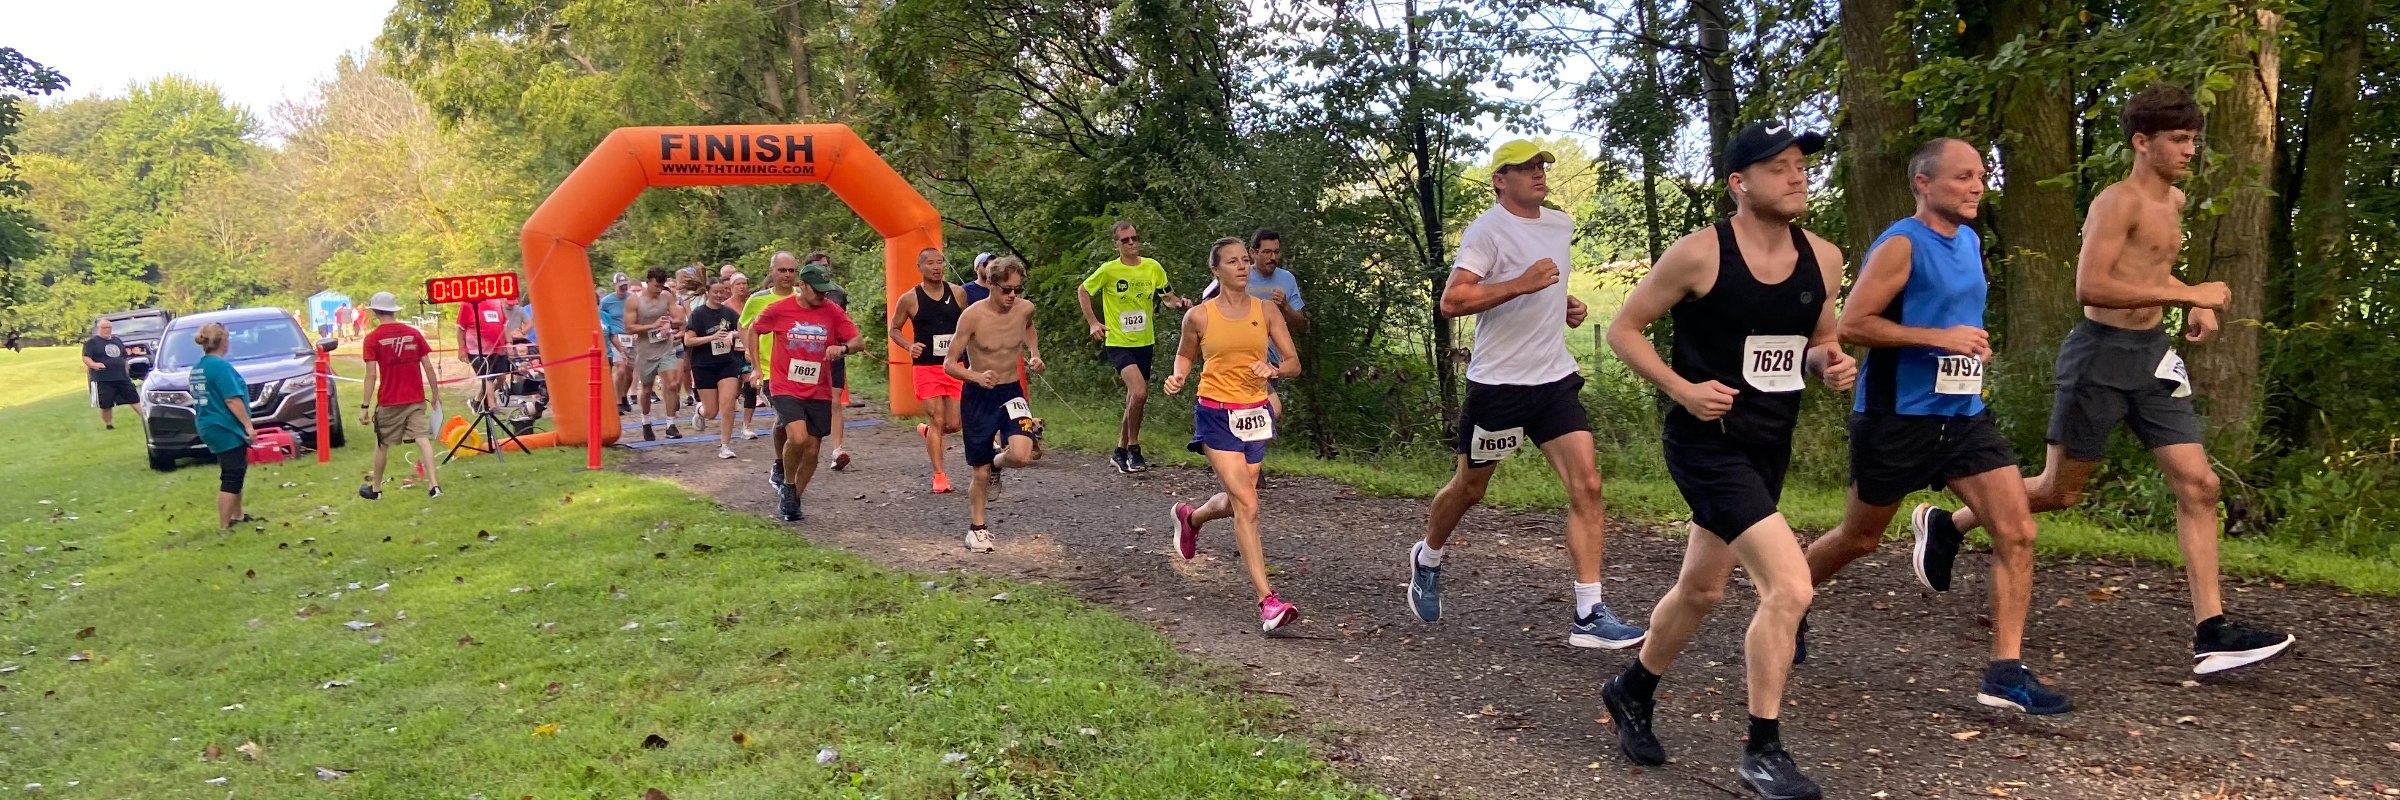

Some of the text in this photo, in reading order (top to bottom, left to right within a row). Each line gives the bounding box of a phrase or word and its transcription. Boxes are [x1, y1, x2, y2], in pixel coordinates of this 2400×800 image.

[661, 134, 814, 163] FINISH
[662, 163, 814, 174] WWW.THTIMING.COM
[433, 276, 513, 301] 0:00:00
[1124, 316, 1143, 325] 7623
[1753, 349, 1794, 372] 7628
[1941, 358, 1981, 376] 4792
[794, 365, 816, 376] 7602
[1236, 415, 1266, 430] 4818
[1479, 436, 1517, 450] 7603
